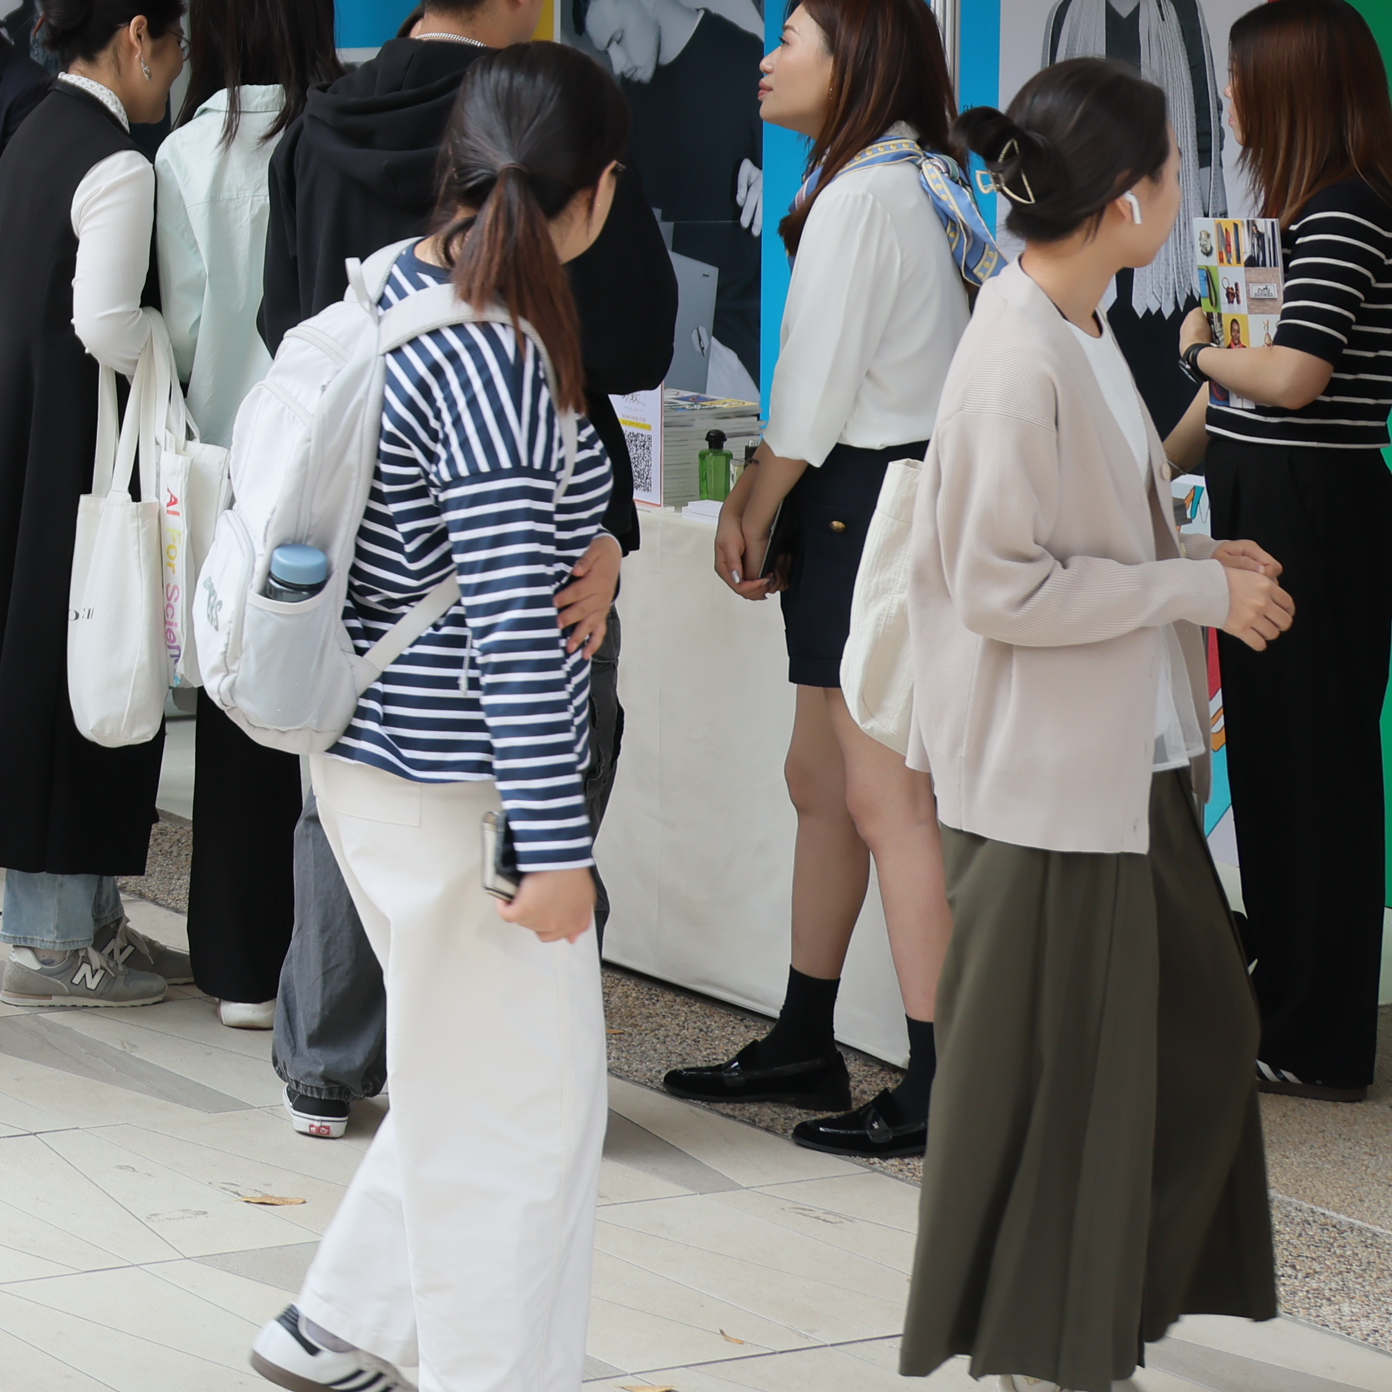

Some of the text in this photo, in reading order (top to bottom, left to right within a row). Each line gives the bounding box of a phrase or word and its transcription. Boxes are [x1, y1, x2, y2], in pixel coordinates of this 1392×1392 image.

[166, 487, 183, 687] AI For Scien
[71, 962, 106, 991] N
